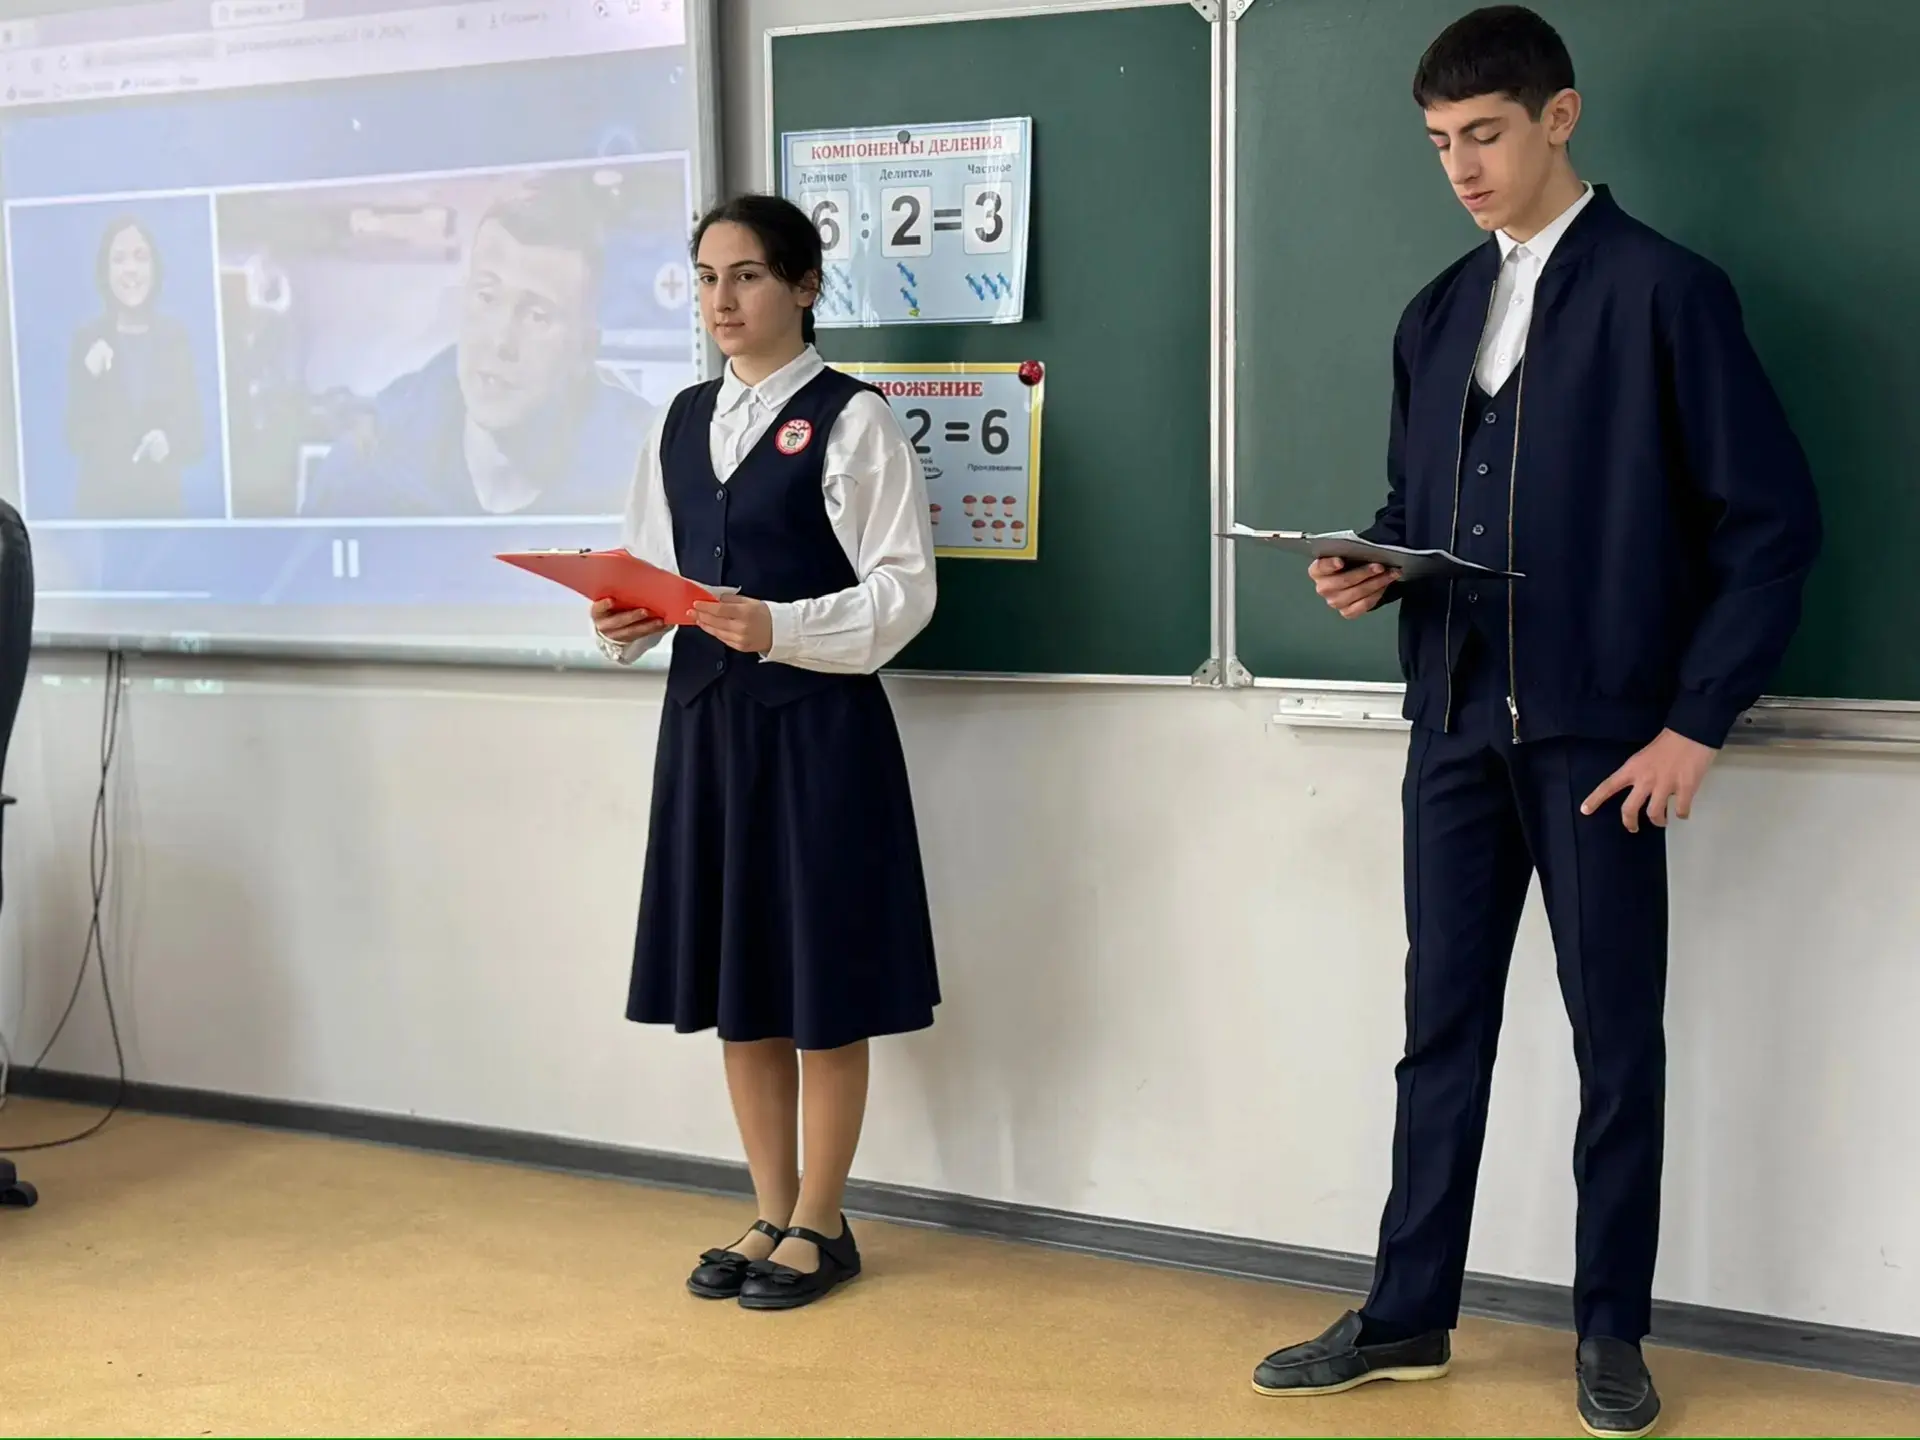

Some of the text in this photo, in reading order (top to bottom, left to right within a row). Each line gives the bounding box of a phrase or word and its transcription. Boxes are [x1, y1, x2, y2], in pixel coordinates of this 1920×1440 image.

[811, 135, 1003, 160] КОМПОНЕНТЫ ДЕЛЕНИЯ
[799, 163, 1012, 185] Делимое Делитель Частное
[811, 200, 840, 251] 6
[891, 195, 922, 246] 2
[975, 191, 1003, 243] 3
[872, 381, 983, 397] НОЖЕНИЕ
[906, 408, 931, 454] 2
[981, 408, 1010, 455] 6
